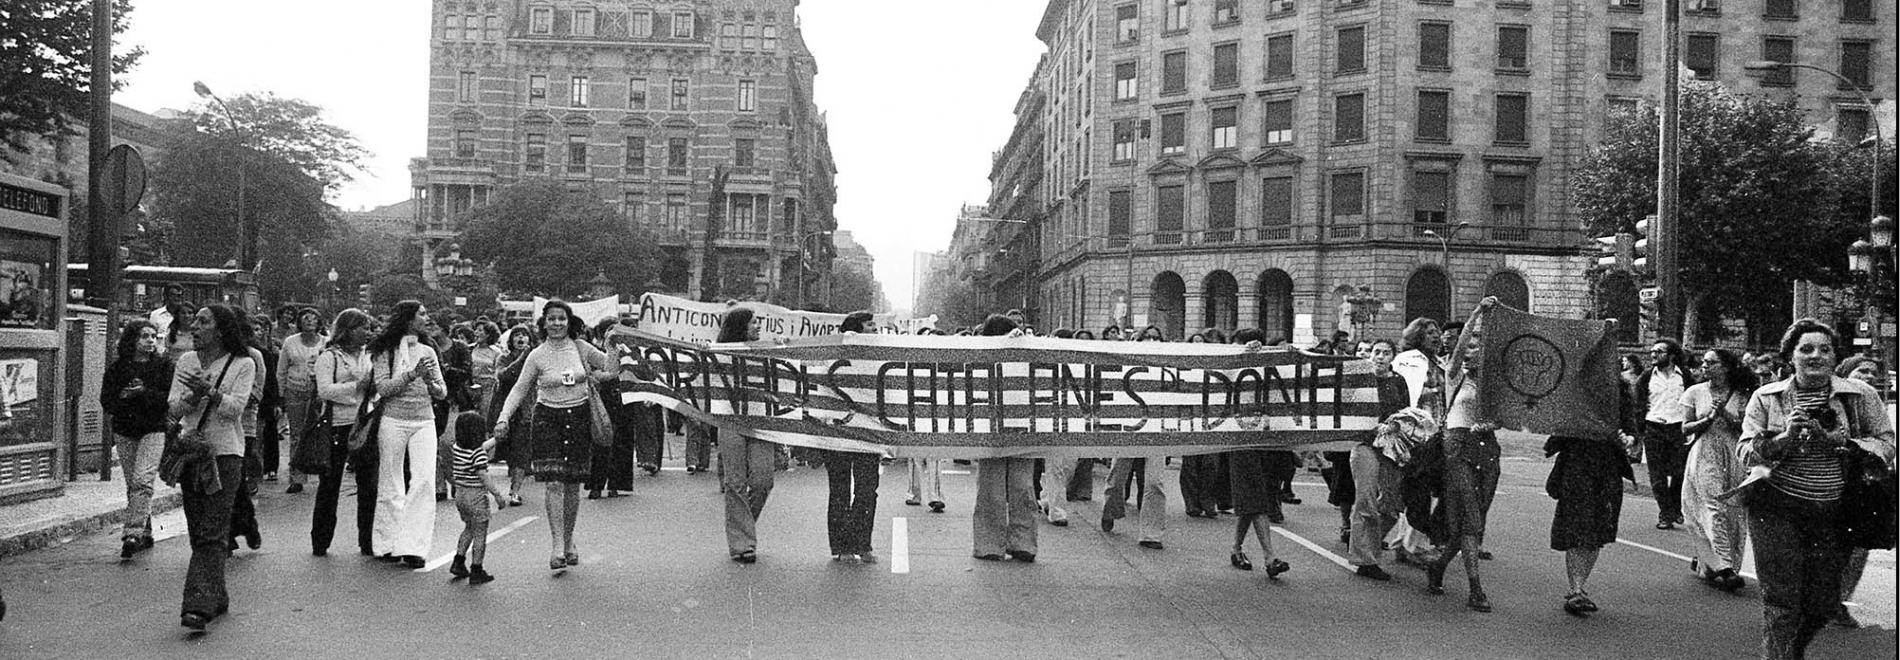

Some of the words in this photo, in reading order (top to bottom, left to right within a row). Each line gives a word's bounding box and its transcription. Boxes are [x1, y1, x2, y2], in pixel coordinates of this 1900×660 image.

[640, 294, 784, 335] ANTICONTIUS
[877, 361, 1149, 433] CATALANES
[1202, 358, 1342, 432] DONA
